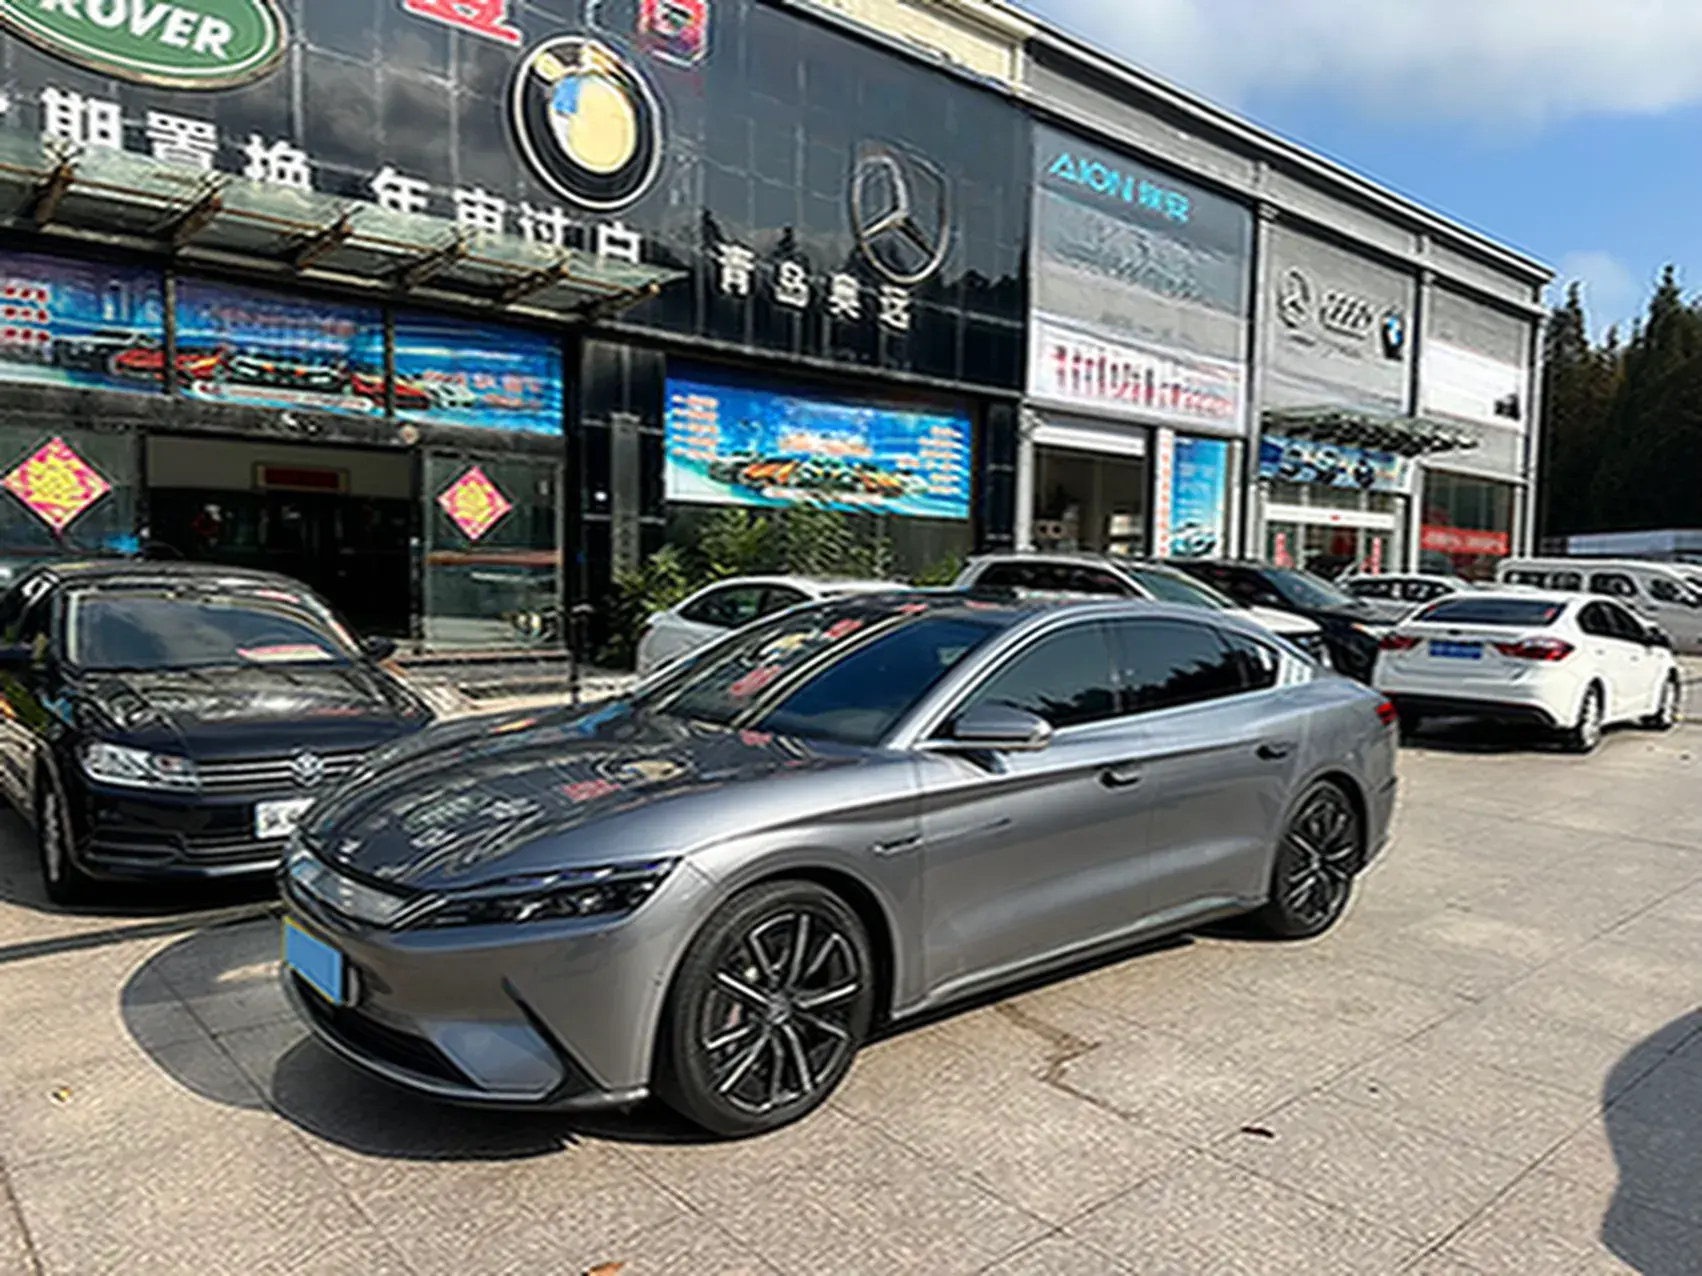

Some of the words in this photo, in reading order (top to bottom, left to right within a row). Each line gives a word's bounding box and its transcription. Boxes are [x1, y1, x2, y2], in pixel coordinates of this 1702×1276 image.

[0, 86, 313, 192] 期置换
[1050, 152, 1136, 204] AION
